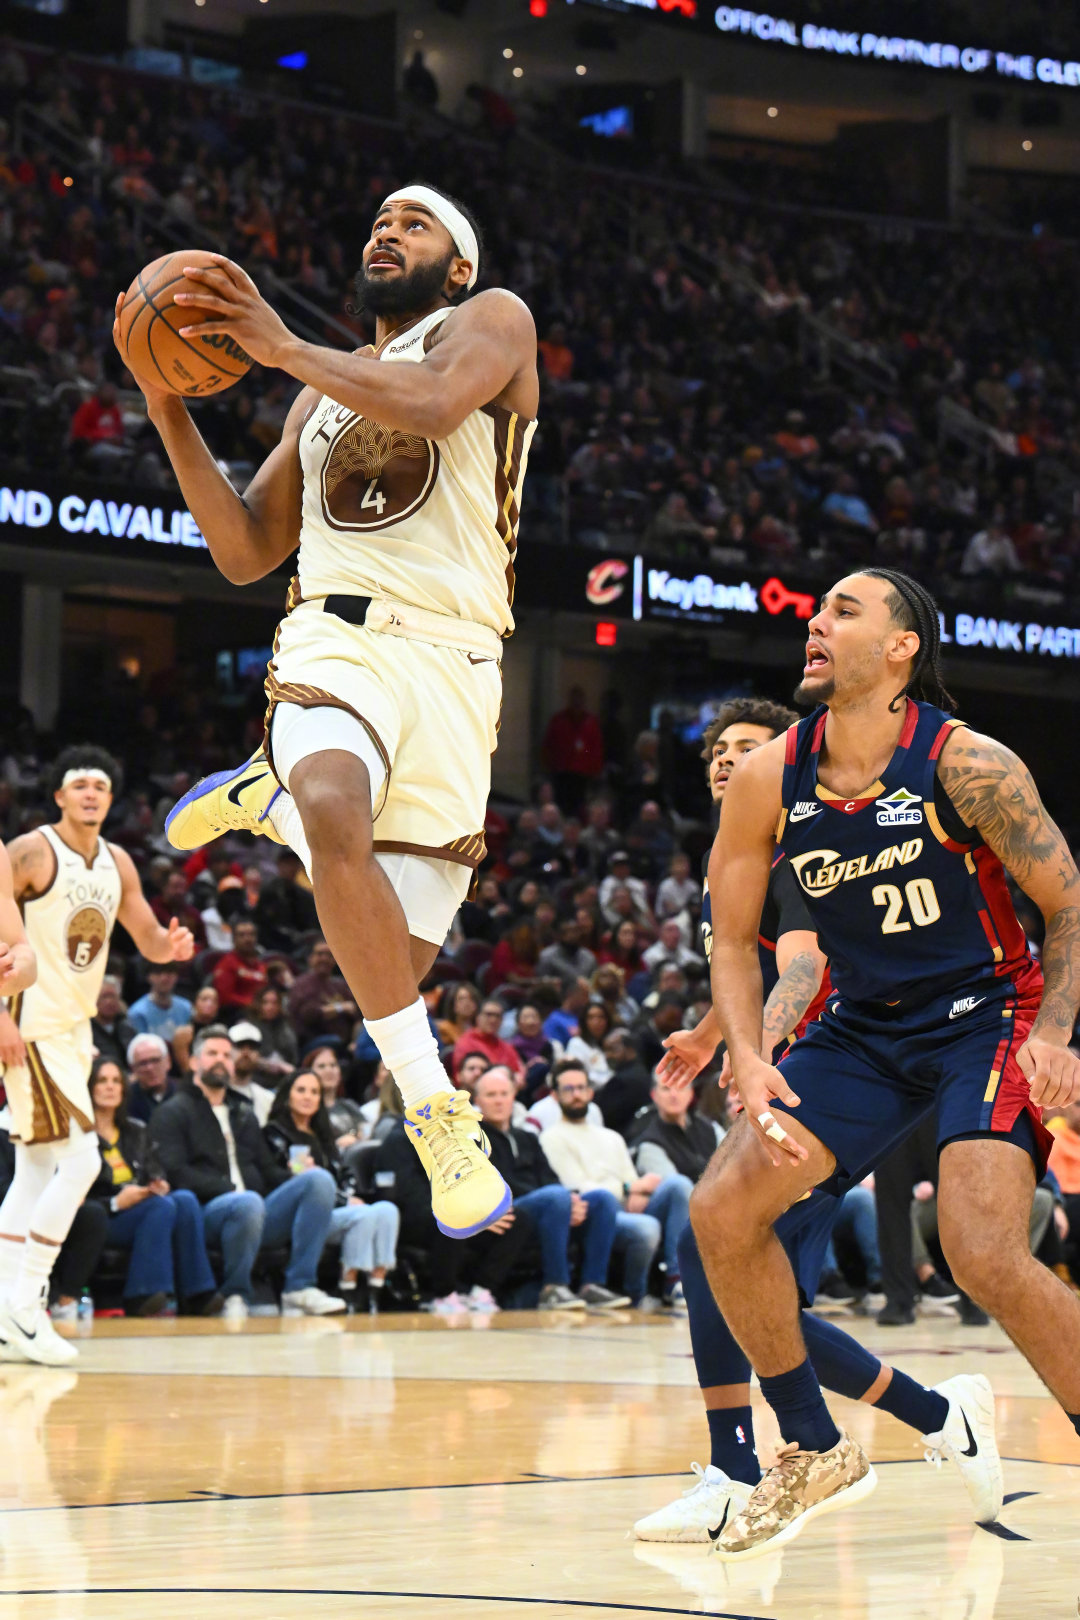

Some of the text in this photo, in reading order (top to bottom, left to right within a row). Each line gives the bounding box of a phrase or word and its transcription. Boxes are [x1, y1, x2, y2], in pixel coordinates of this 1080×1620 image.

[714, 5, 800, 46] OFFICIAL
[802, 23, 860, 56] BANK
[861, 33, 960, 69] PARTNER
[960, 47, 991, 72] OF
[996, 51, 1034, 80] THE
[361, 478, 386, 514] 4
[0, 486, 209, 548] ND CAVALIE
[648, 569, 759, 613] KeyBank
[955, 613, 1023, 652] BANK
[793, 801, 818, 814] NIKE
[878, 811, 922, 823] CLIFFS
[789, 837, 924, 898] CLEVELAND
[64, 883, 114, 912] TOWN
[871, 877, 942, 935] 20
[952, 996, 976, 1014] NIKE
